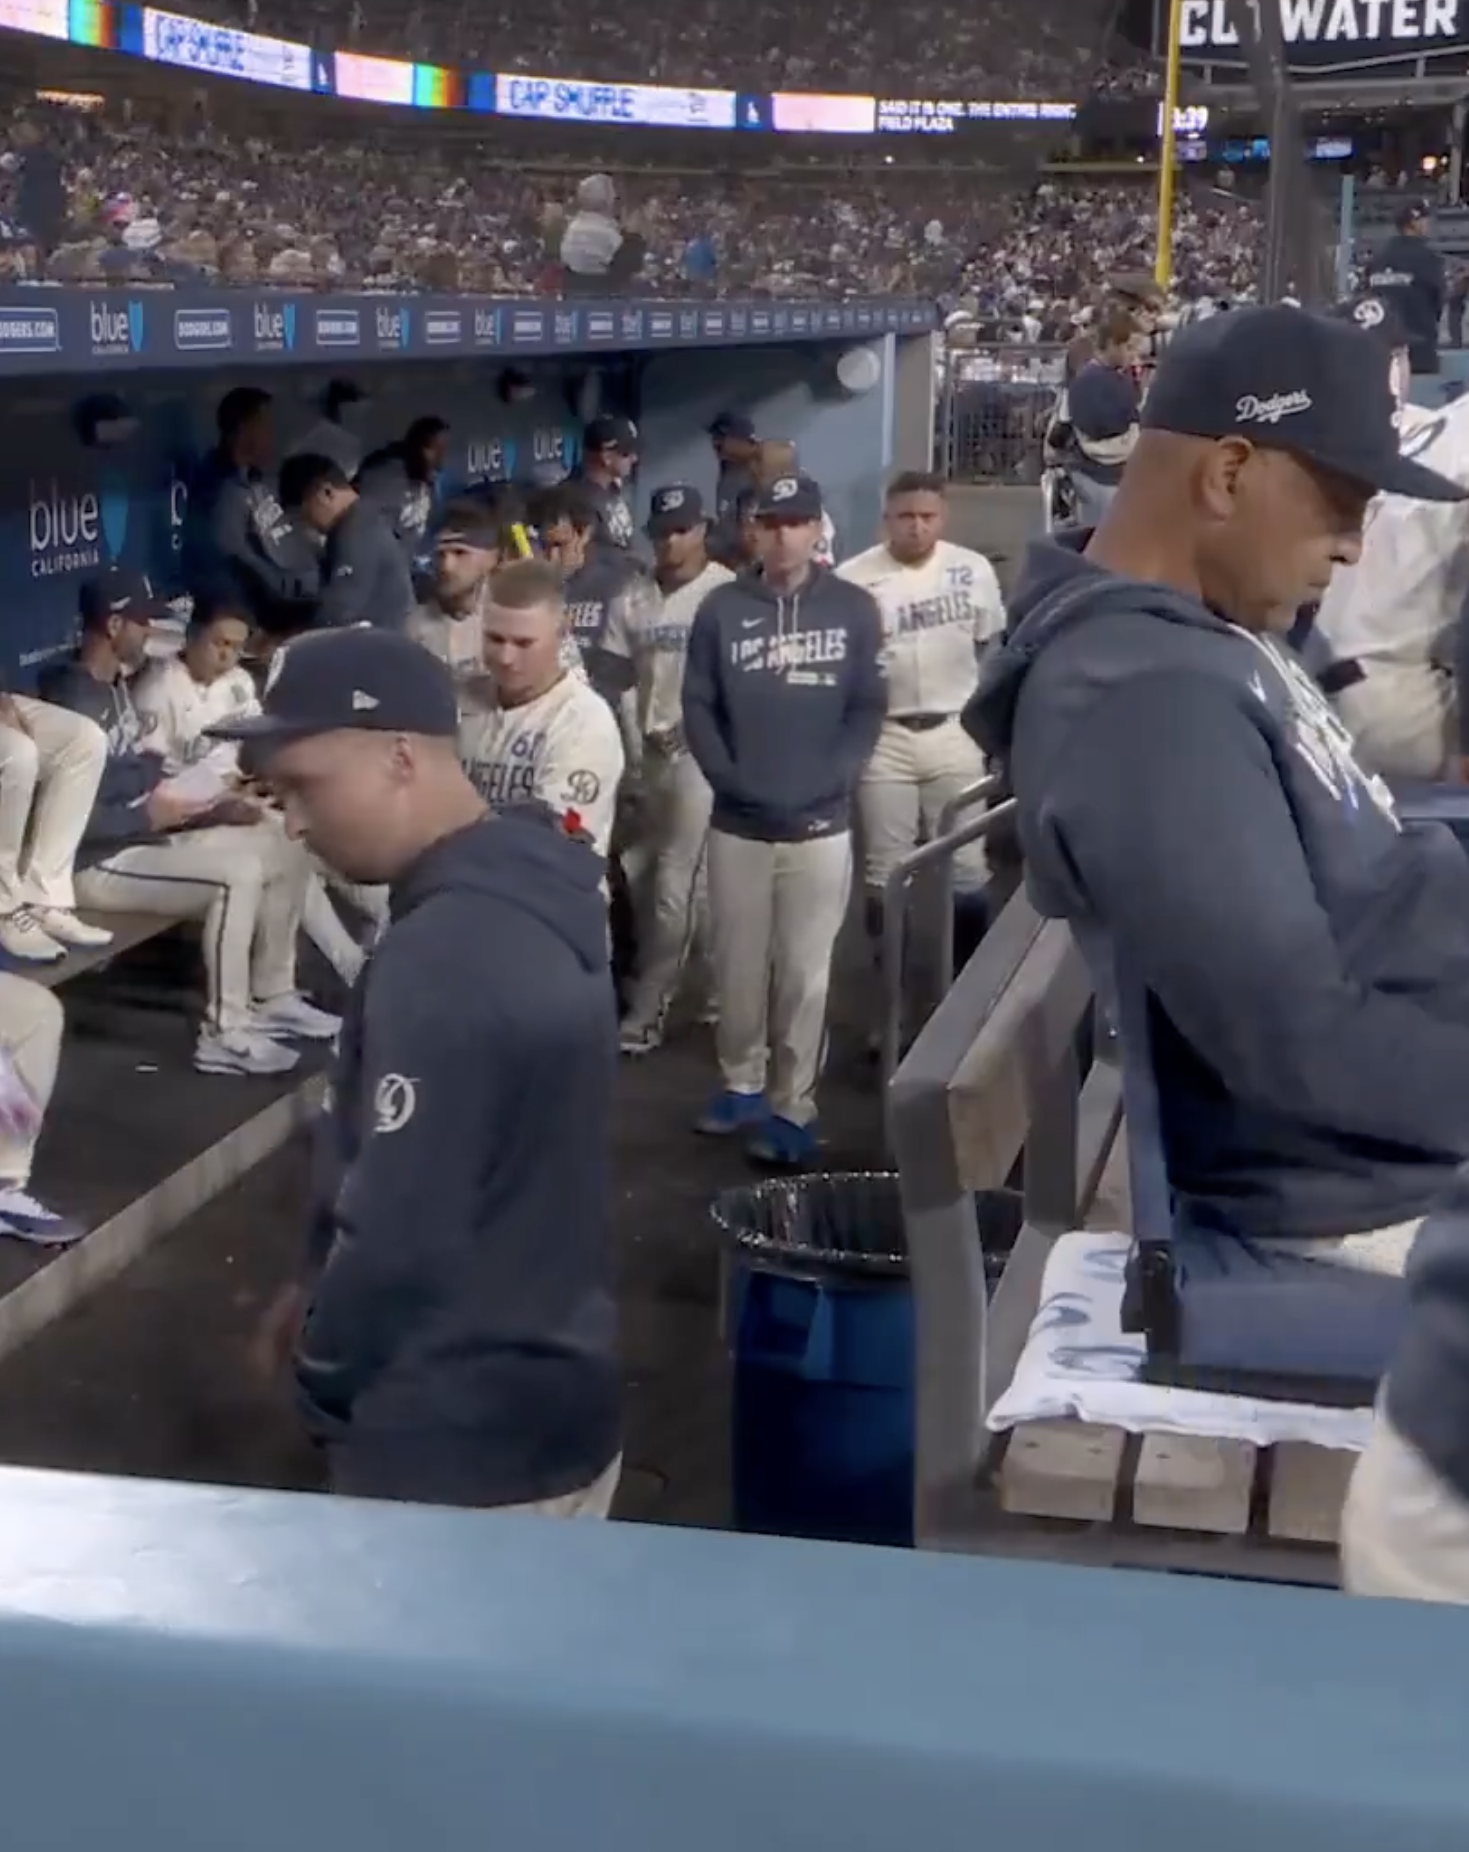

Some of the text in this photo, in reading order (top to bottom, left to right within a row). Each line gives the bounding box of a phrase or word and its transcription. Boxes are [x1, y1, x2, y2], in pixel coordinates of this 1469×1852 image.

[509, 80, 547, 111] CAP
[90, 300, 128, 342] blue
[254, 301, 283, 338] blue
[1235, 389, 1312, 424] Dodgers
[31, 477, 98, 551] blue
[31, 548, 99, 577] CALIFORNIA
[946, 566, 973, 586] 72
[767, 628, 848, 669] ANGELES
